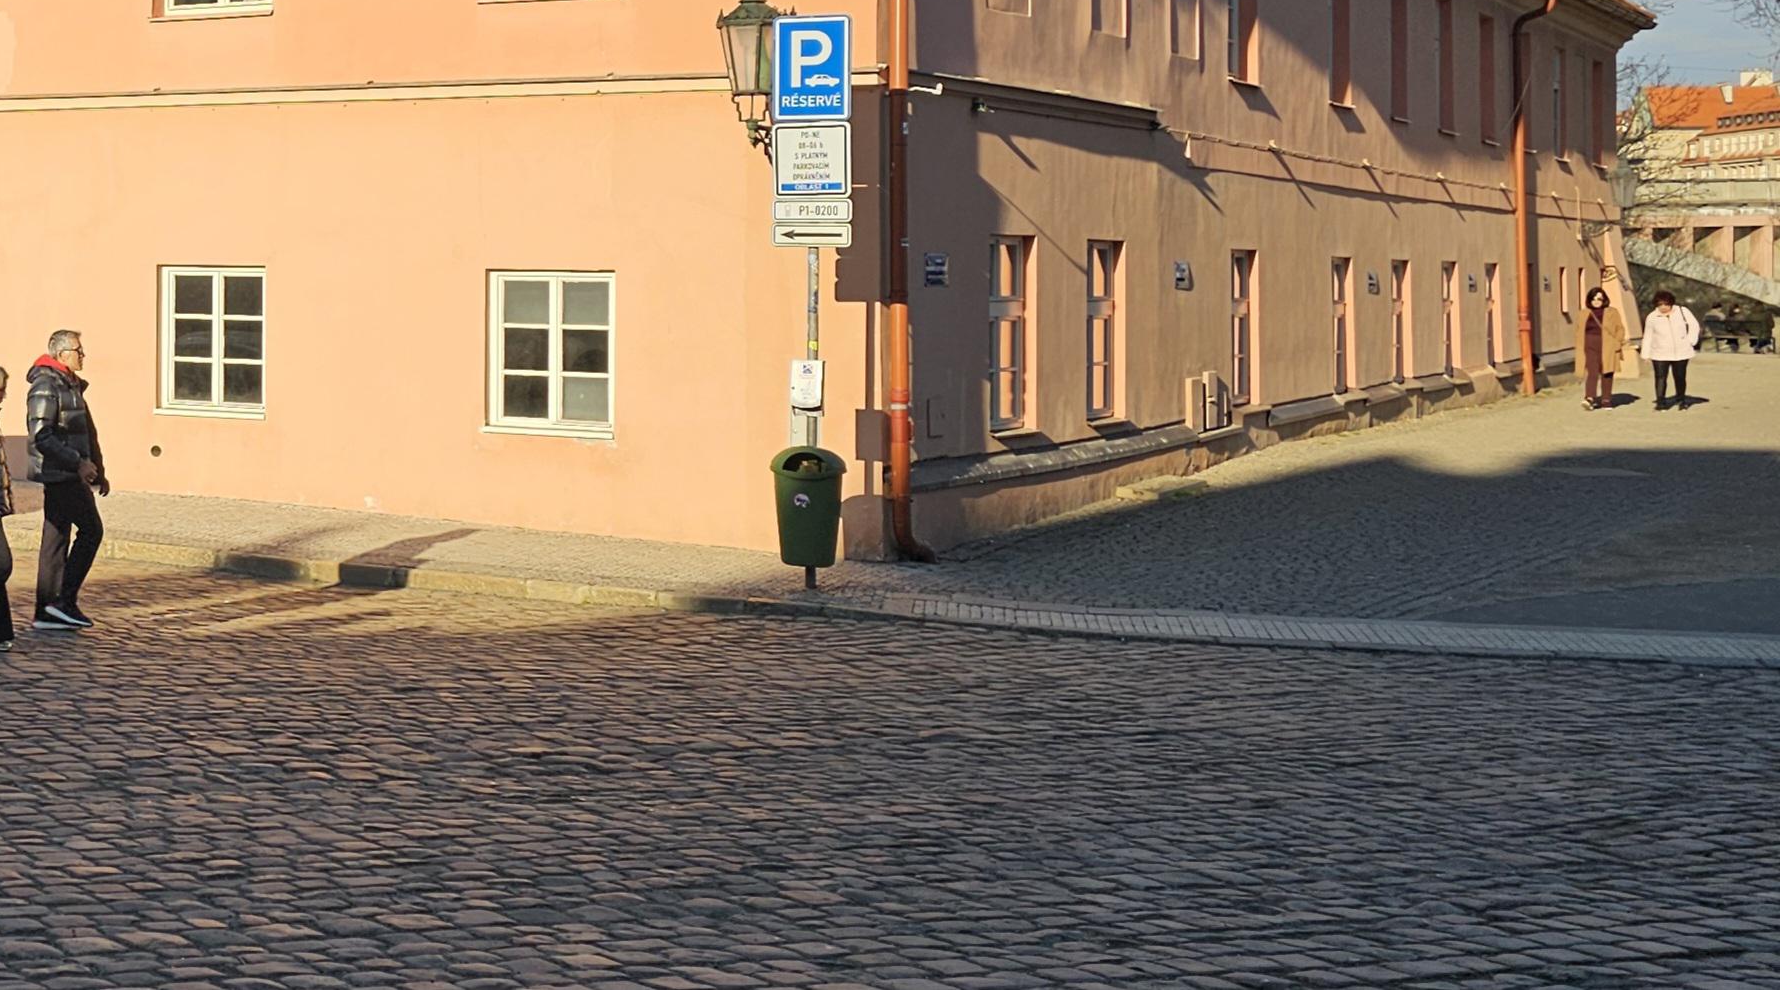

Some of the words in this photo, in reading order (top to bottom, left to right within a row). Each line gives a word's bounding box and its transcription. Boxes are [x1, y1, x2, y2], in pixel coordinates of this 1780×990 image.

[791, 30, 833, 89] P
[781, 92, 842, 107] RÉSERVÉ
[798, 205, 838, 216] P1-0200
